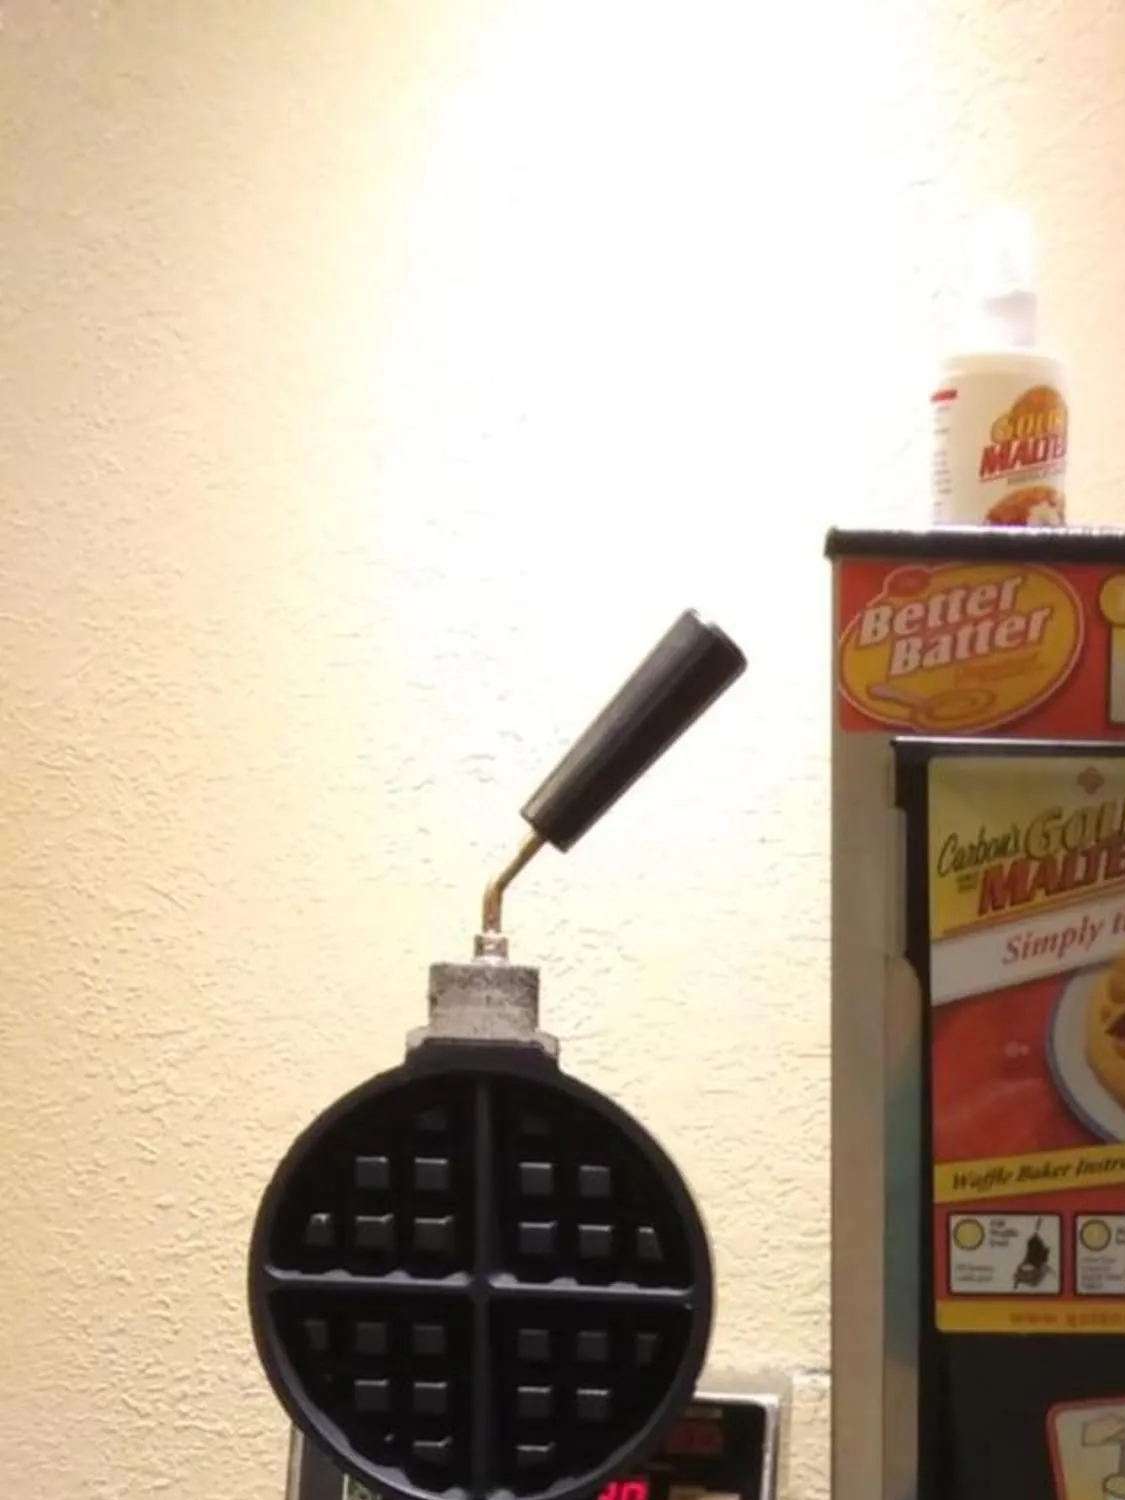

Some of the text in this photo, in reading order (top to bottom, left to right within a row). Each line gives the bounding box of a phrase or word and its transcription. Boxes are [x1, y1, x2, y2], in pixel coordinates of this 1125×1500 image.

[859, 575, 1024, 646] Better
[890, 607, 1052, 677] Batter
[1001, 914, 1104, 965] Simply
[951, 1166, 1014, 1193] Waffle
[1017, 1161, 1073, 1184] Baker
